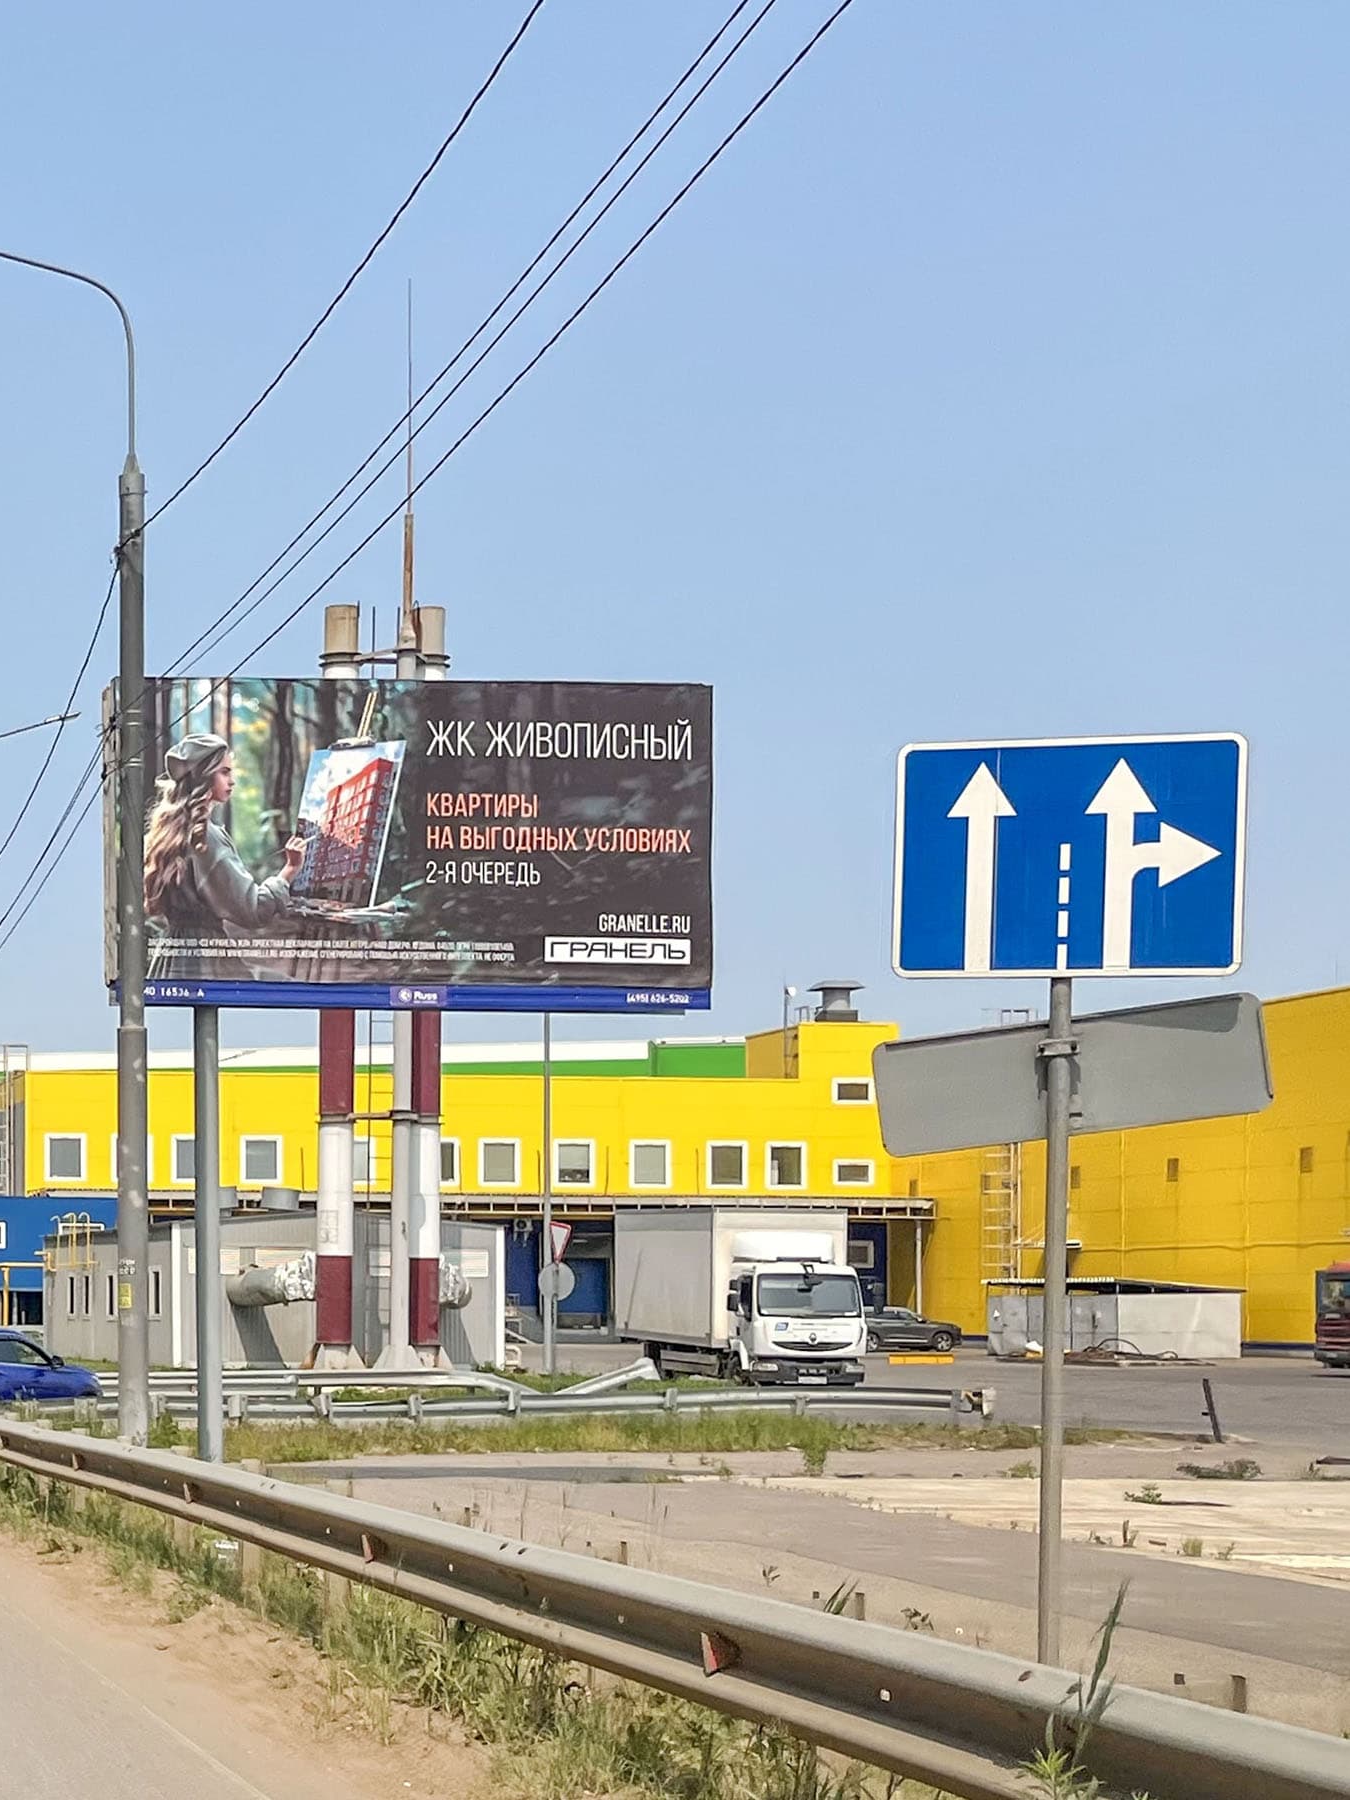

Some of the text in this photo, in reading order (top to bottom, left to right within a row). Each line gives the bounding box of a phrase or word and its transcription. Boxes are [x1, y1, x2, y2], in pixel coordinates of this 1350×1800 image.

[425, 718, 692, 761] ЖК ЖИВОПИСНЫЙ
[426, 792, 538, 819] КВАРТИРЫ
[426, 825, 692, 853] НА ВЫГОДНЫХ УСЛОВИЯХ
[425, 860, 541, 888] 2-Я ОЧЕРЕДЬ
[598, 913, 691, 934] GRANELLE.RU
[550, 941, 687, 961] ГРАНЕЛЬ
